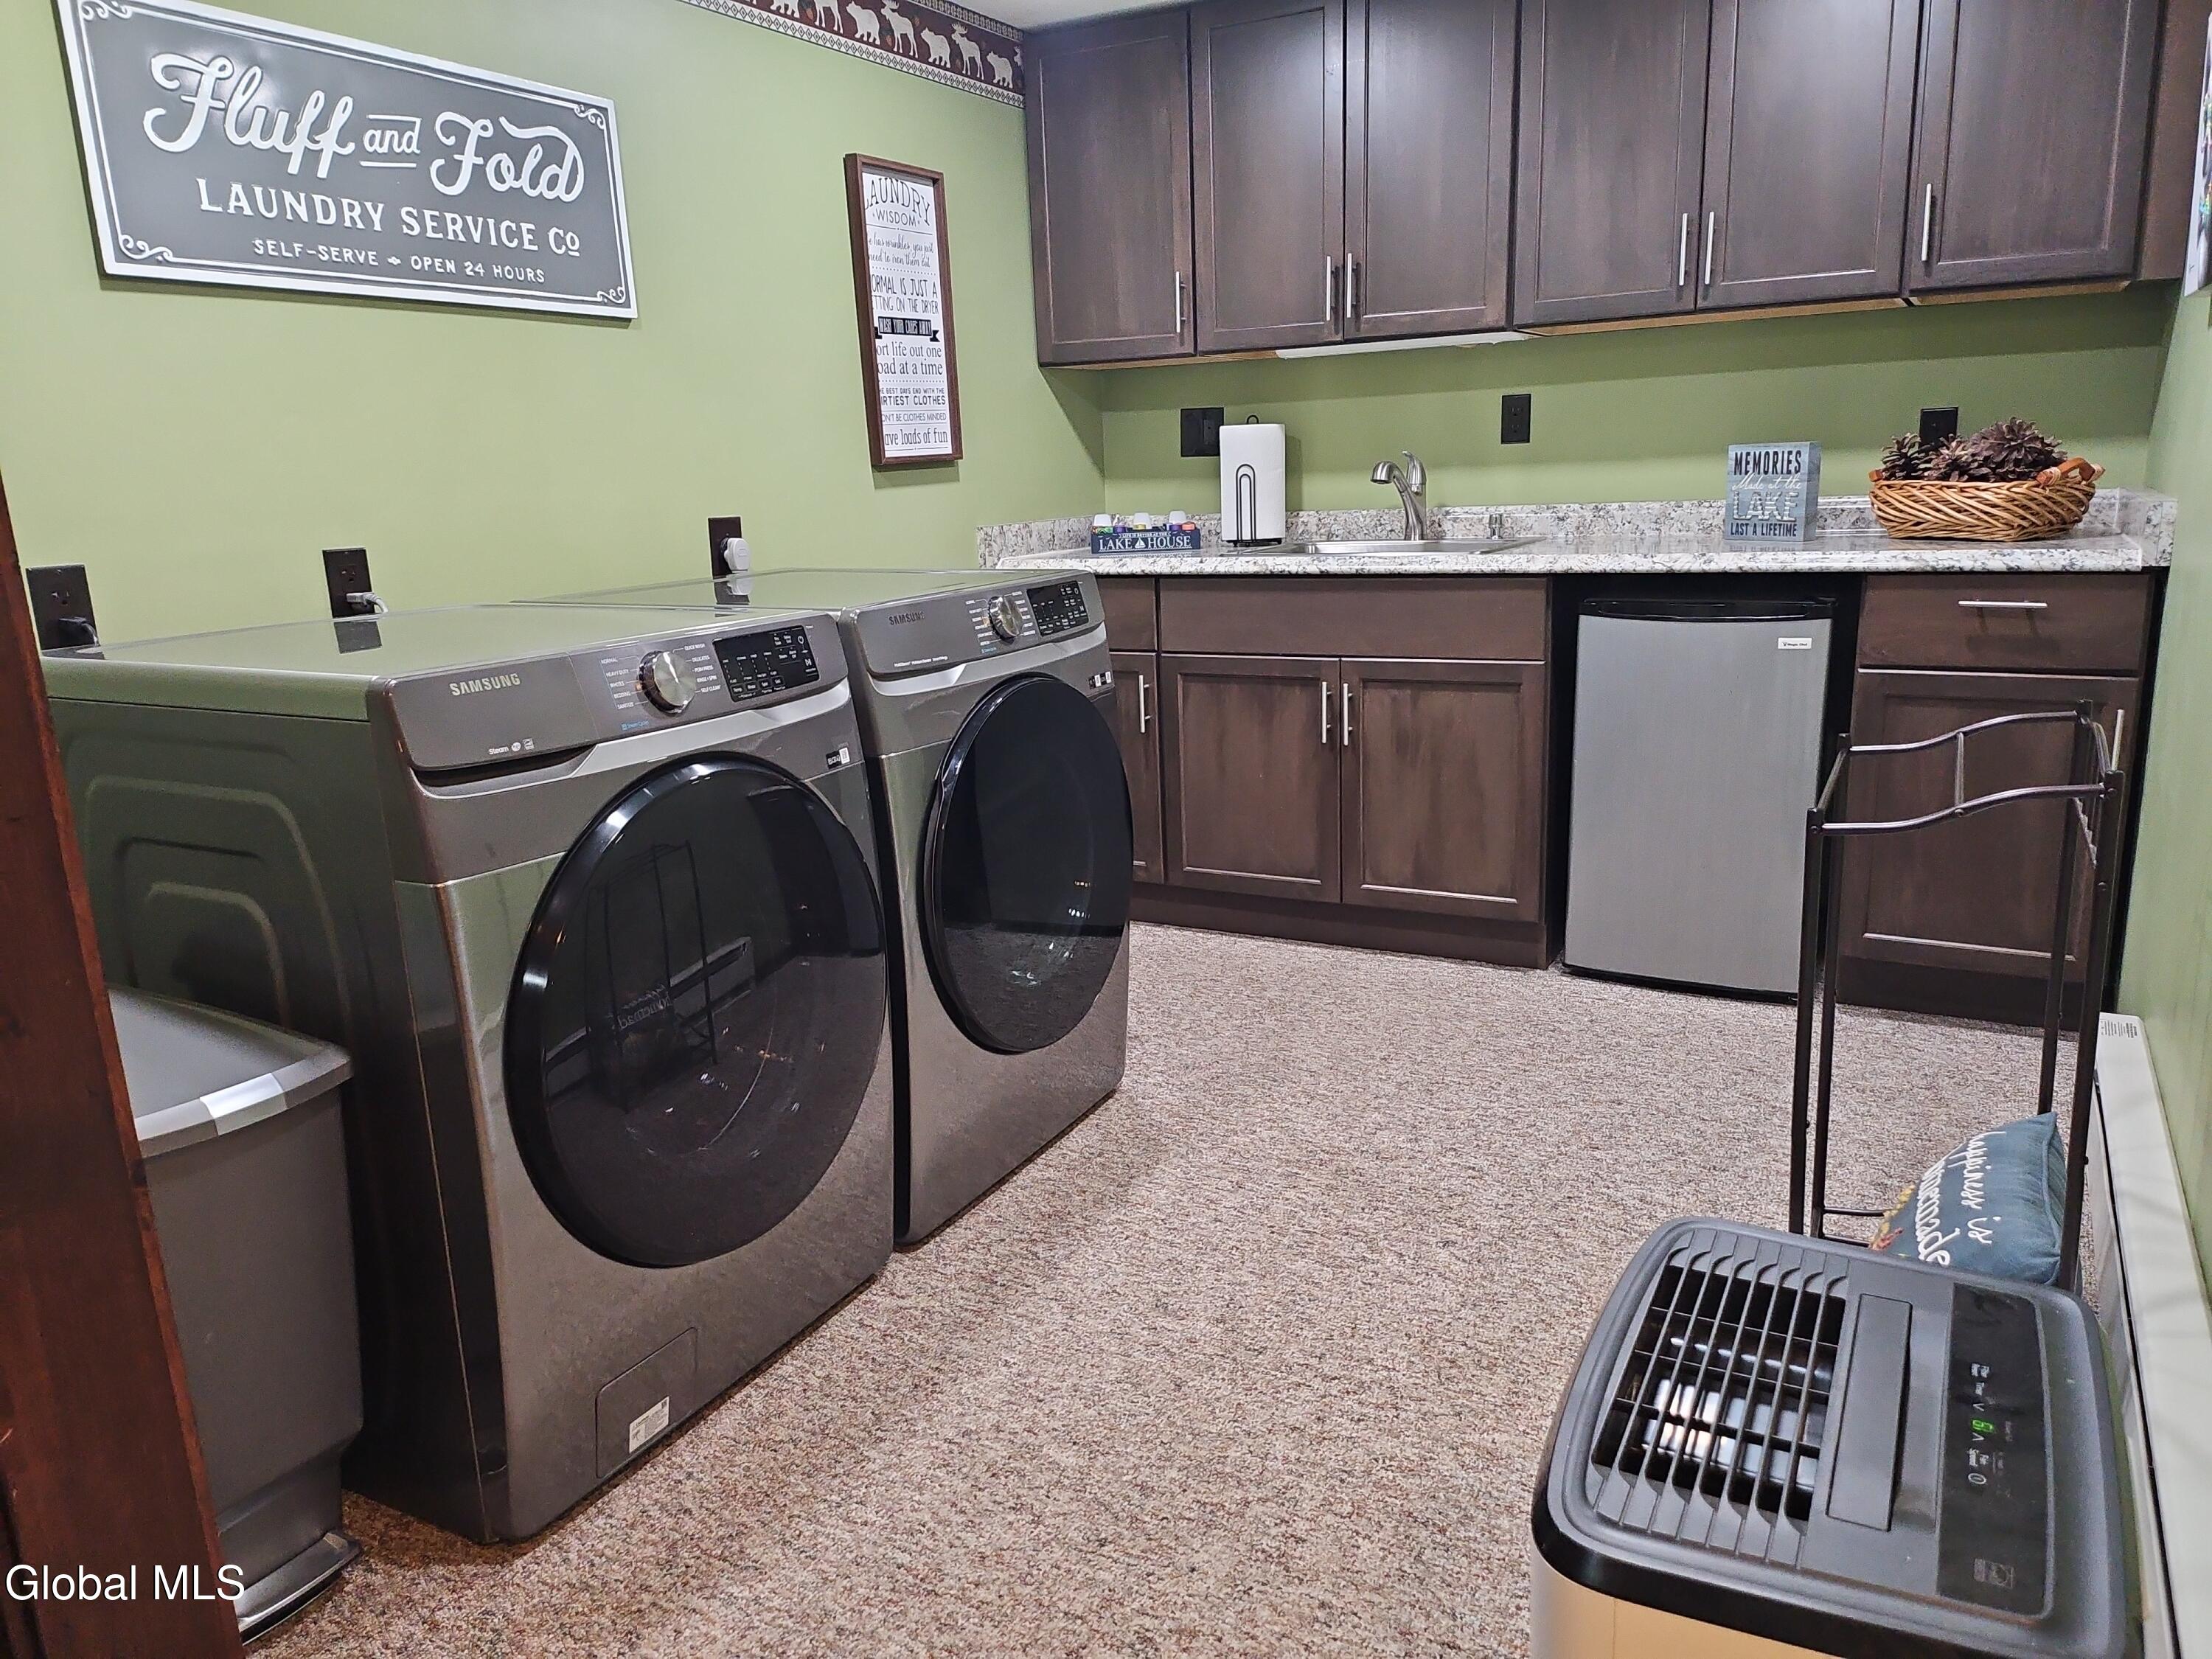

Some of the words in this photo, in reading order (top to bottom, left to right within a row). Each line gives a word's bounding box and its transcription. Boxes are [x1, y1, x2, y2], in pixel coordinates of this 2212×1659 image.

[143, 53, 355, 178] Fluff
[363, 116, 422, 153] and
[430, 111, 584, 202] Fold
[865, 177, 931, 226] AUNDRY
[196, 178, 384, 232] LAUNDRY
[400, 206, 539, 251] SERVICE
[875, 208, 917, 227] WISDOM
[874, 232, 885, 246] has
[913, 243, 923, 258] you
[922, 242, 933, 260] just
[253, 238, 379, 266] SELF-SERVE
[411, 255, 456, 274] OPEN
[464, 261, 485, 277] 24
[493, 264, 545, 284] HOURS
[883, 251, 891, 262] to
[891, 254, 904, 265] iron
[905, 252, 919, 266] them
[871, 274, 897, 294] ORMAL
[900, 277, 907, 295] IS
[910, 278, 928, 297] JUST
[932, 281, 938, 299] A
[872, 295, 894, 311] TTING
[896, 296, 905, 313] ON
[907, 297, 919, 313] THE
[921, 299, 939, 315] DRYER
[876, 343, 889, 356] ort
[891, 341, 908, 357] life
[909, 345, 924, 358] out
[926, 347, 942, 358] one
[877, 357, 897, 375] oad
[899, 360, 909, 375] at
[911, 362, 918, 375] a
[920, 358, 943, 375] time
[880, 395, 909, 406] IRTIEST
[914, 394, 946, 406] CLOTHES
[882, 413, 894, 422] ON'T
[895, 413, 902, 422] BE
[902, 412, 926, 422] CLOTHES
[926, 412, 947, 421] MINDED
[884, 433, 899, 446] ave
[900, 428, 922, 445] loads
[923, 428, 931, 444] of
[933, 427, 948, 444] fun
[1733, 450, 1802, 476] MEMORIES
[1733, 491, 1799, 523] LAKE
[1730, 522, 1750, 536] LAST
[1752, 522, 1758, 536] A
[1761, 522, 1798, 538] LIFETIME
[1099, 539, 1132, 550] LAKE
[1148, 536, 1191, 549] HOUSE
[888, 611, 926, 626] SAMSUNG
[449, 672, 521, 696] SAMSUNG
[488, 746, 509, 755] Steam
[1947, 1131, 2007, 1210] happiness
[1966, 1216, 2002, 1245] is
